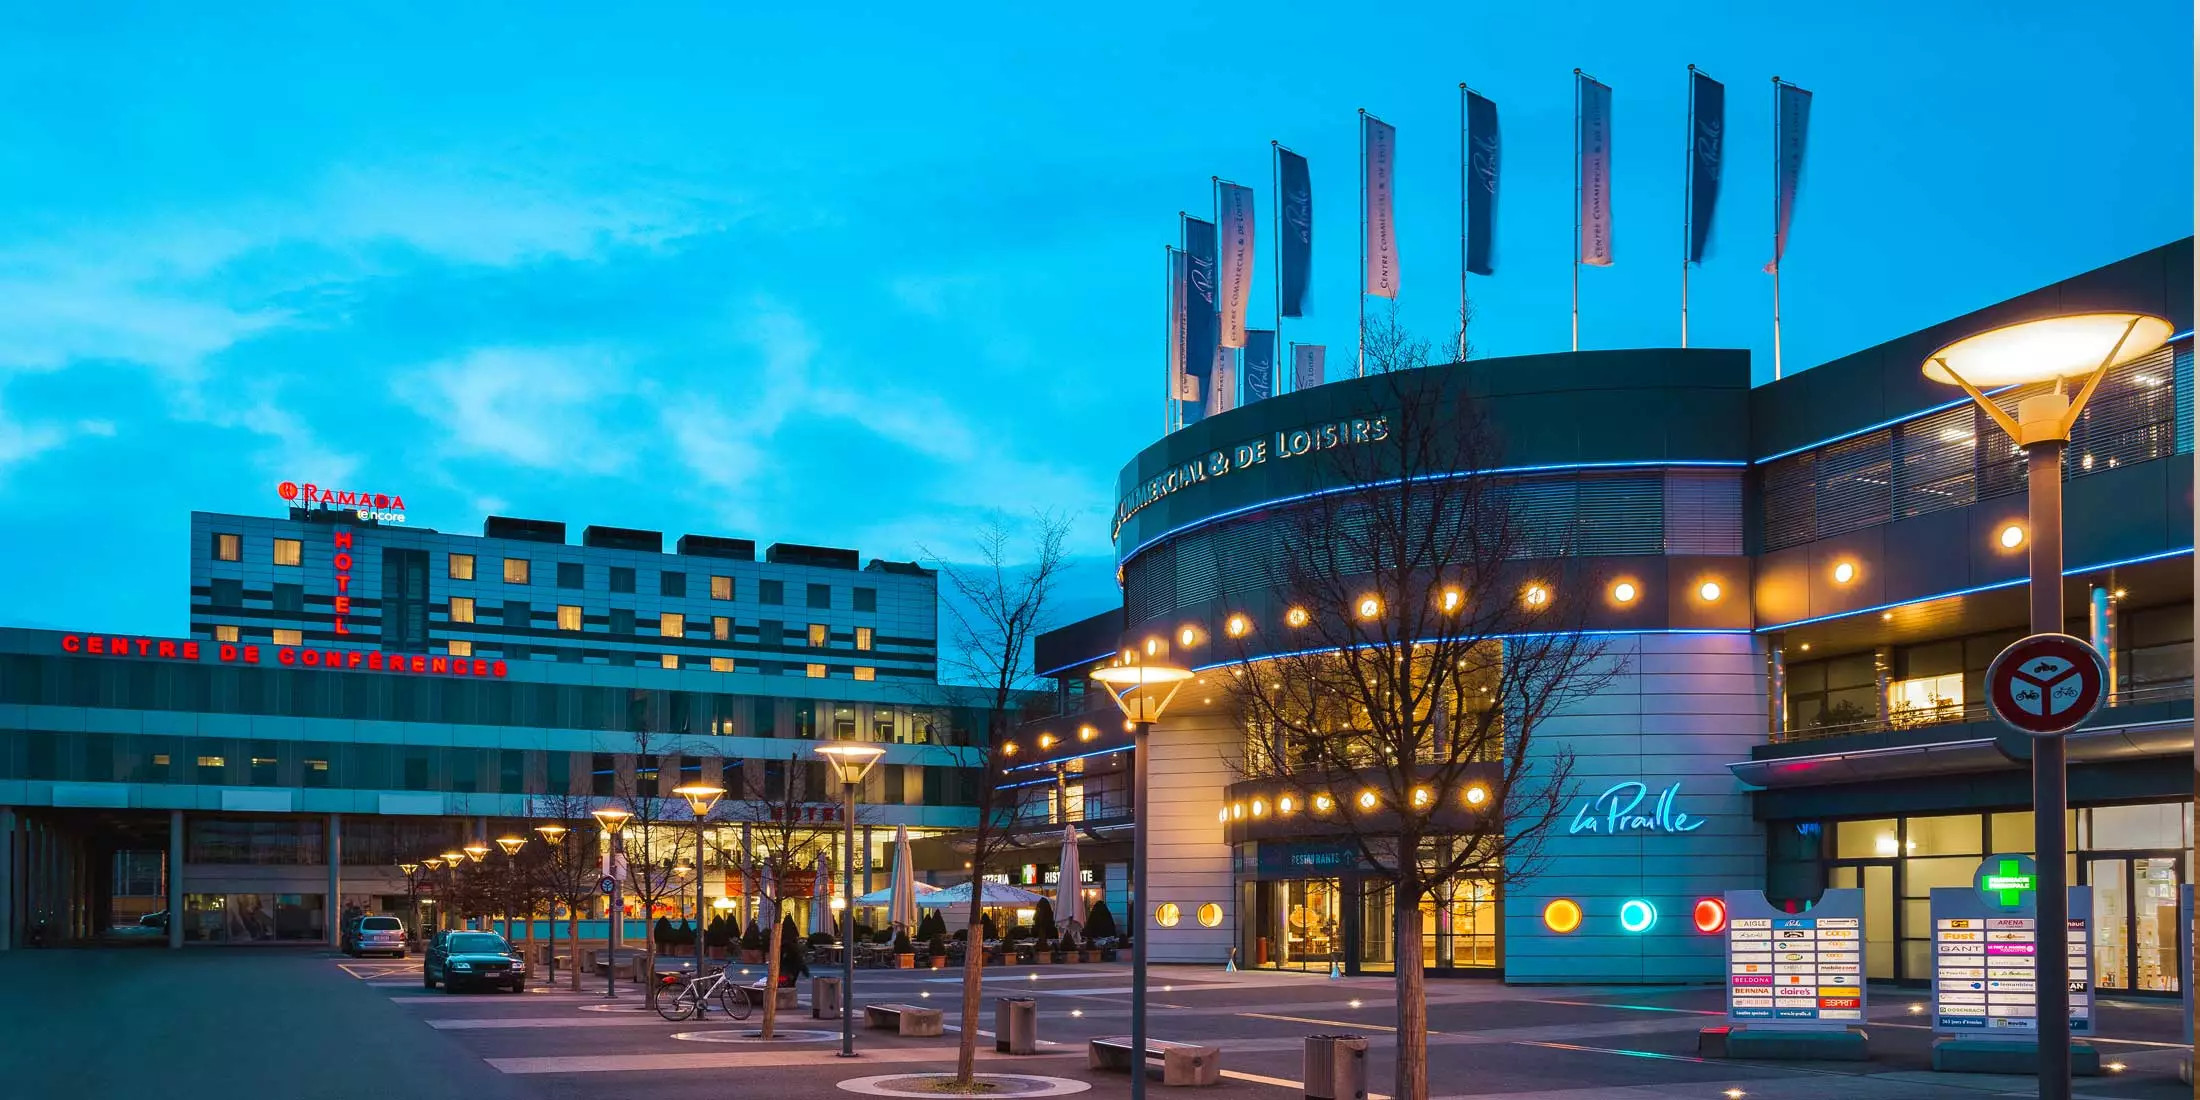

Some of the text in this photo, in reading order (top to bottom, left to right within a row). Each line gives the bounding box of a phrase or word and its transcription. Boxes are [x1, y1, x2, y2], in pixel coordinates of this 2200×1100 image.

[1378, 193, 1388, 252] COMMERCIAL
[1230, 248, 1244, 307] COMMERCIAL
[1380, 255, 1389, 289] CENTRE
[1230, 310, 1238, 342] CENTRE
[1207, 450, 1229, 476] &
[1234, 439, 1266, 468] DE
[1275, 415, 1388, 458] LOISIRS
[303, 483, 405, 510] RAMADA
[358, 509, 406, 523] encore
[335, 531, 353, 635] HOTEL
[62, 635, 200, 660] CENTRE
[220, 643, 260, 664] DE
[1569, 781, 1706, 835] La Praille
[1780, 987, 1811, 995] claire's
